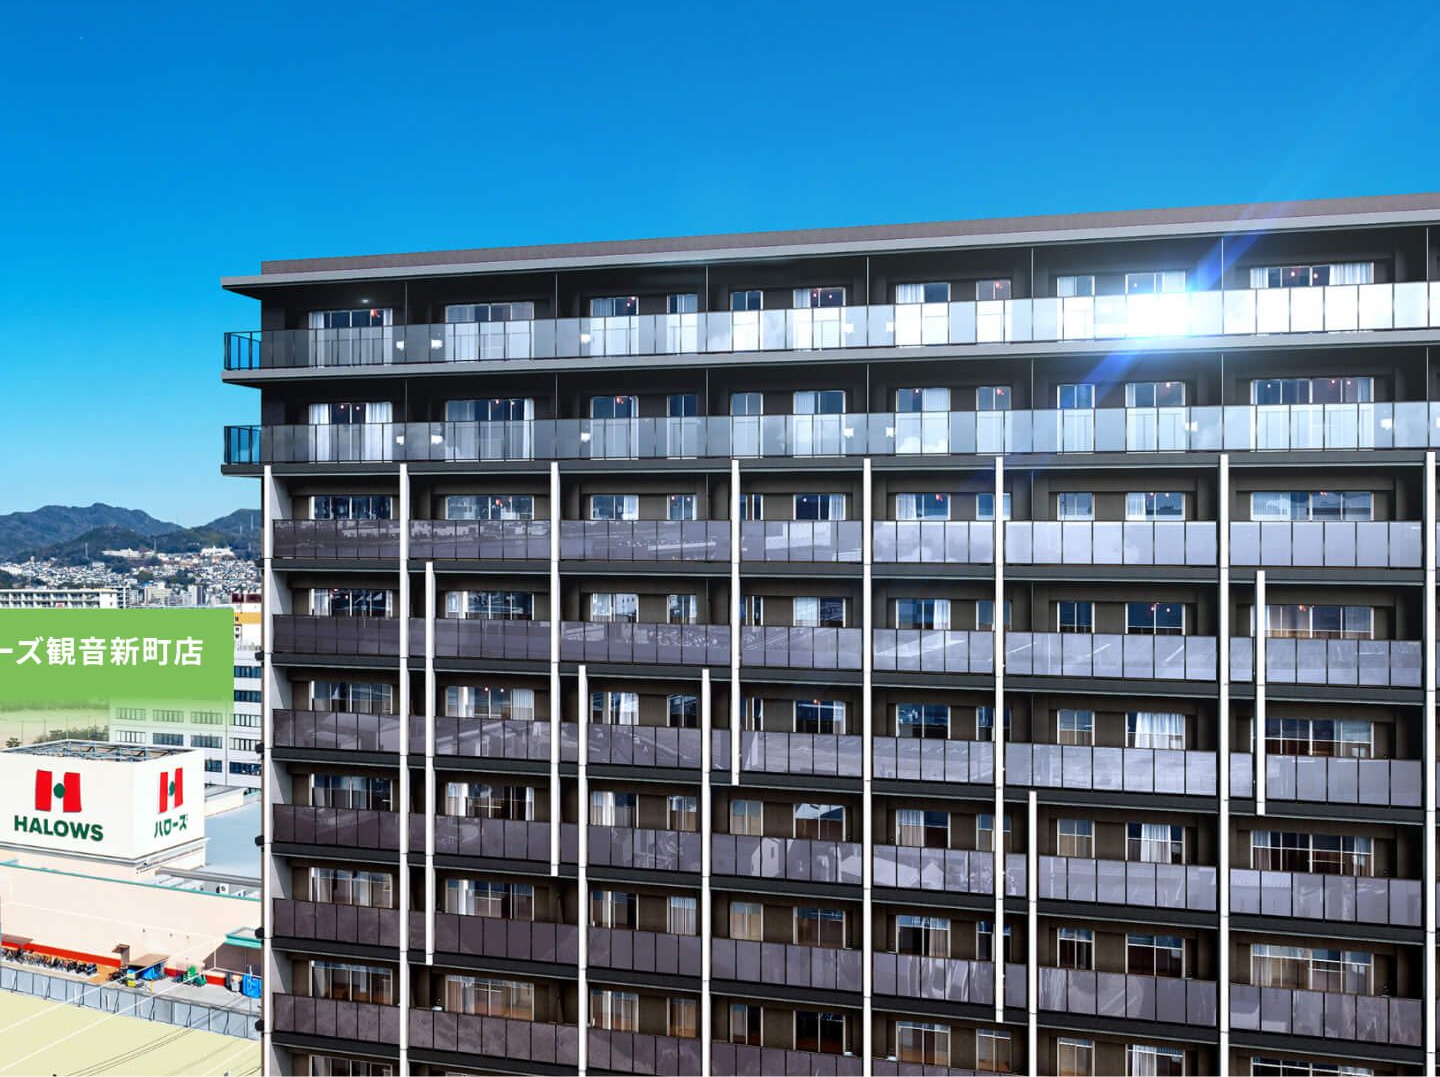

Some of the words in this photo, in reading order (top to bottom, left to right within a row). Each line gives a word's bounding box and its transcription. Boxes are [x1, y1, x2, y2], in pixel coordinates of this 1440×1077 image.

[13, 814, 104, 842] HALOWS
[154, 813, 189, 839] ハローズ
